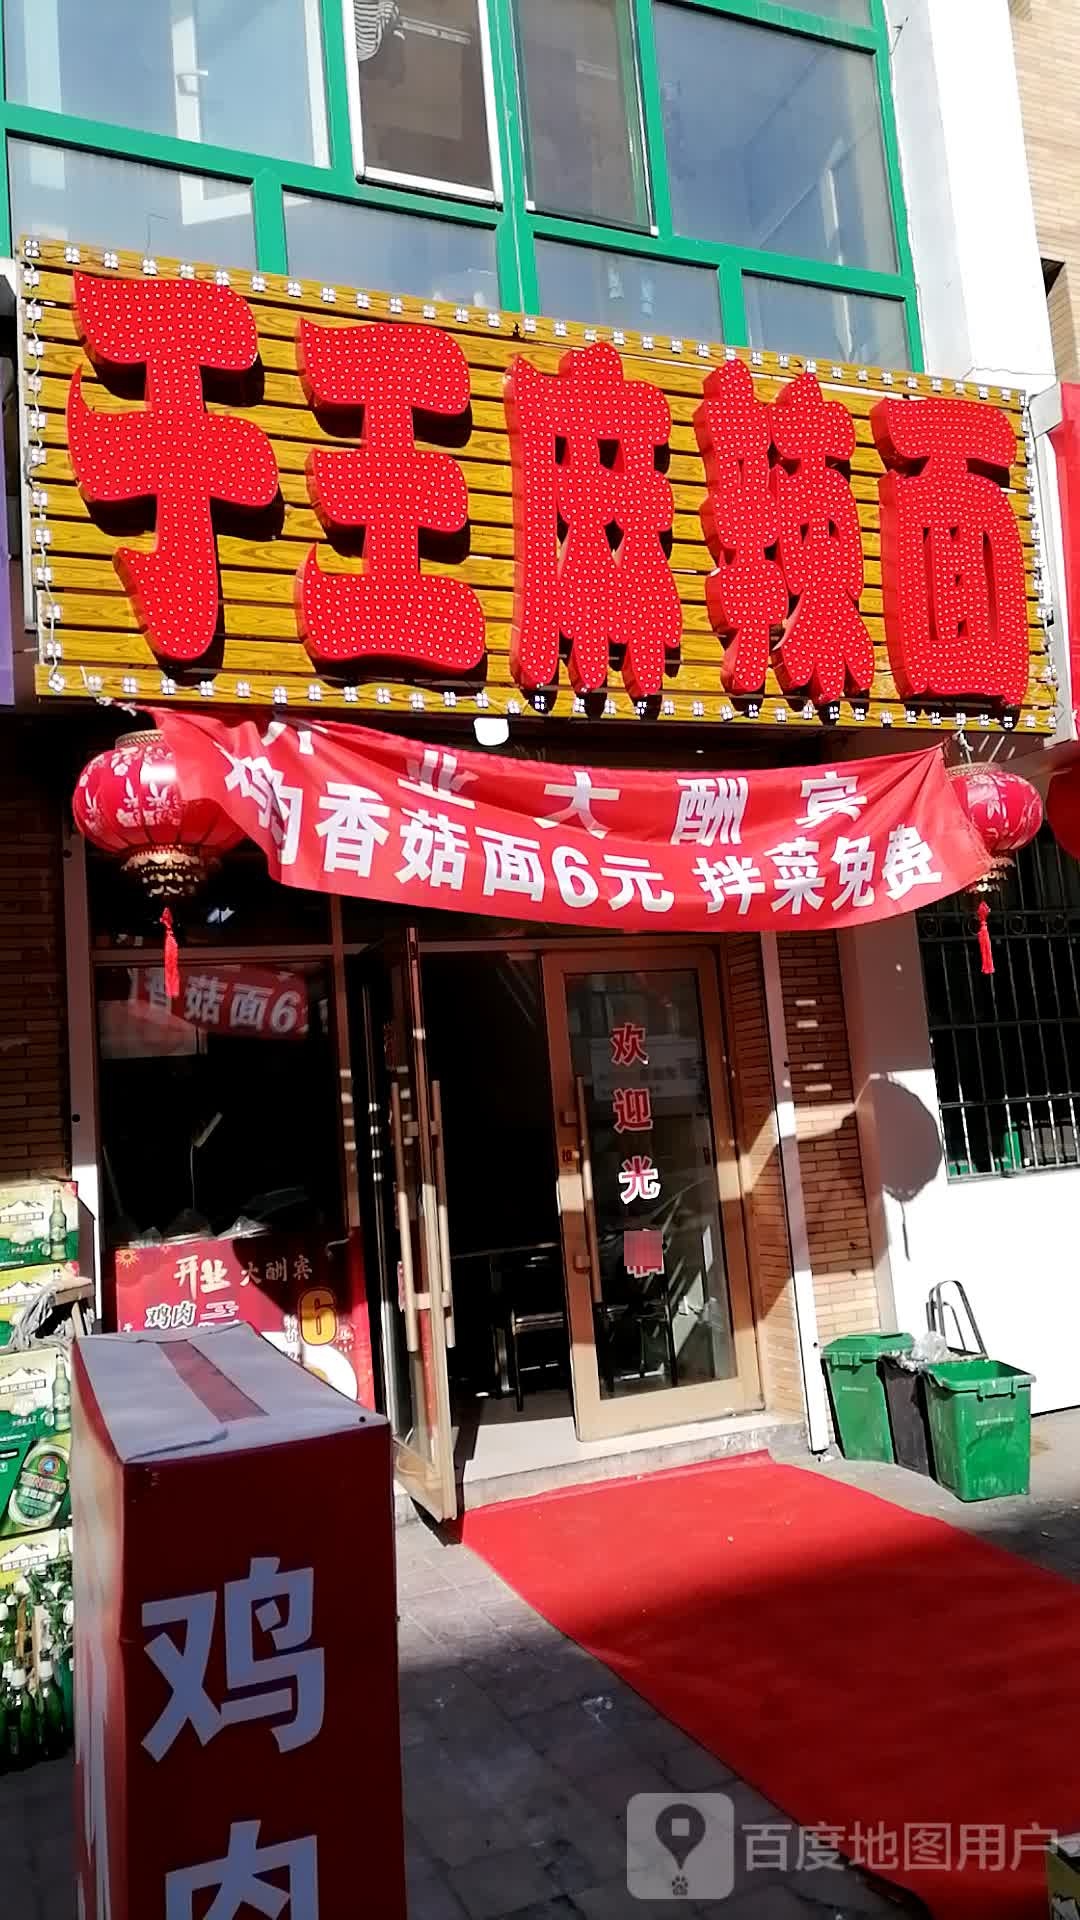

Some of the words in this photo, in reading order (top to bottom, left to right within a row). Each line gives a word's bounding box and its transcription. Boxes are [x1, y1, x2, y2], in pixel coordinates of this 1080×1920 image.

[67, 272, 1030, 707] 于王麻辣面
[691, 823, 943, 916] 拌菜免费
[610, 1022, 665, 1278] 欢迎光
[173, 1254, 313, 1301] 开业大酬宾
[299, 1287, 338, 1346] 6
